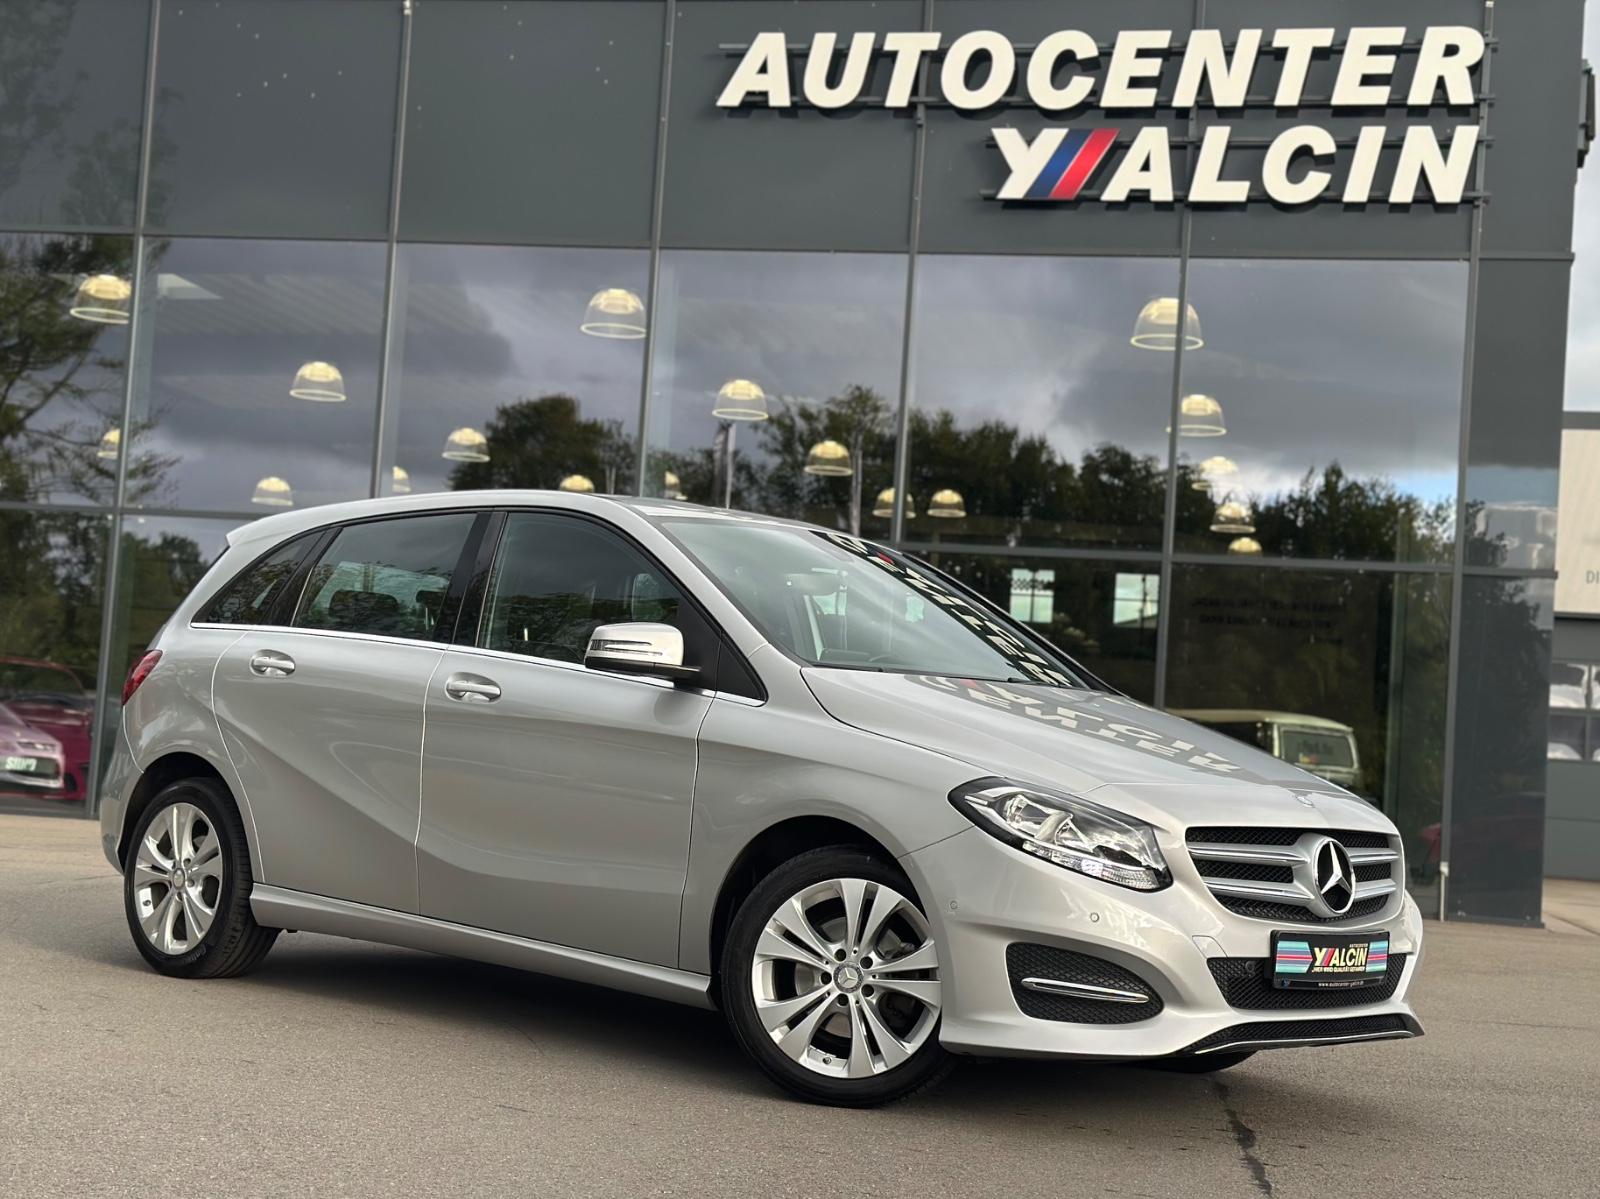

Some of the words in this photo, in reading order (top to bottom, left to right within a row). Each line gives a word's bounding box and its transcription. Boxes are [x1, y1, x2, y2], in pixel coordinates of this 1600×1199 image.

[716, 26, 1485, 110] AUTOCENTER
[991, 125, 1480, 204] YALCIN
[1313, 947, 1368, 967] YALCIN
